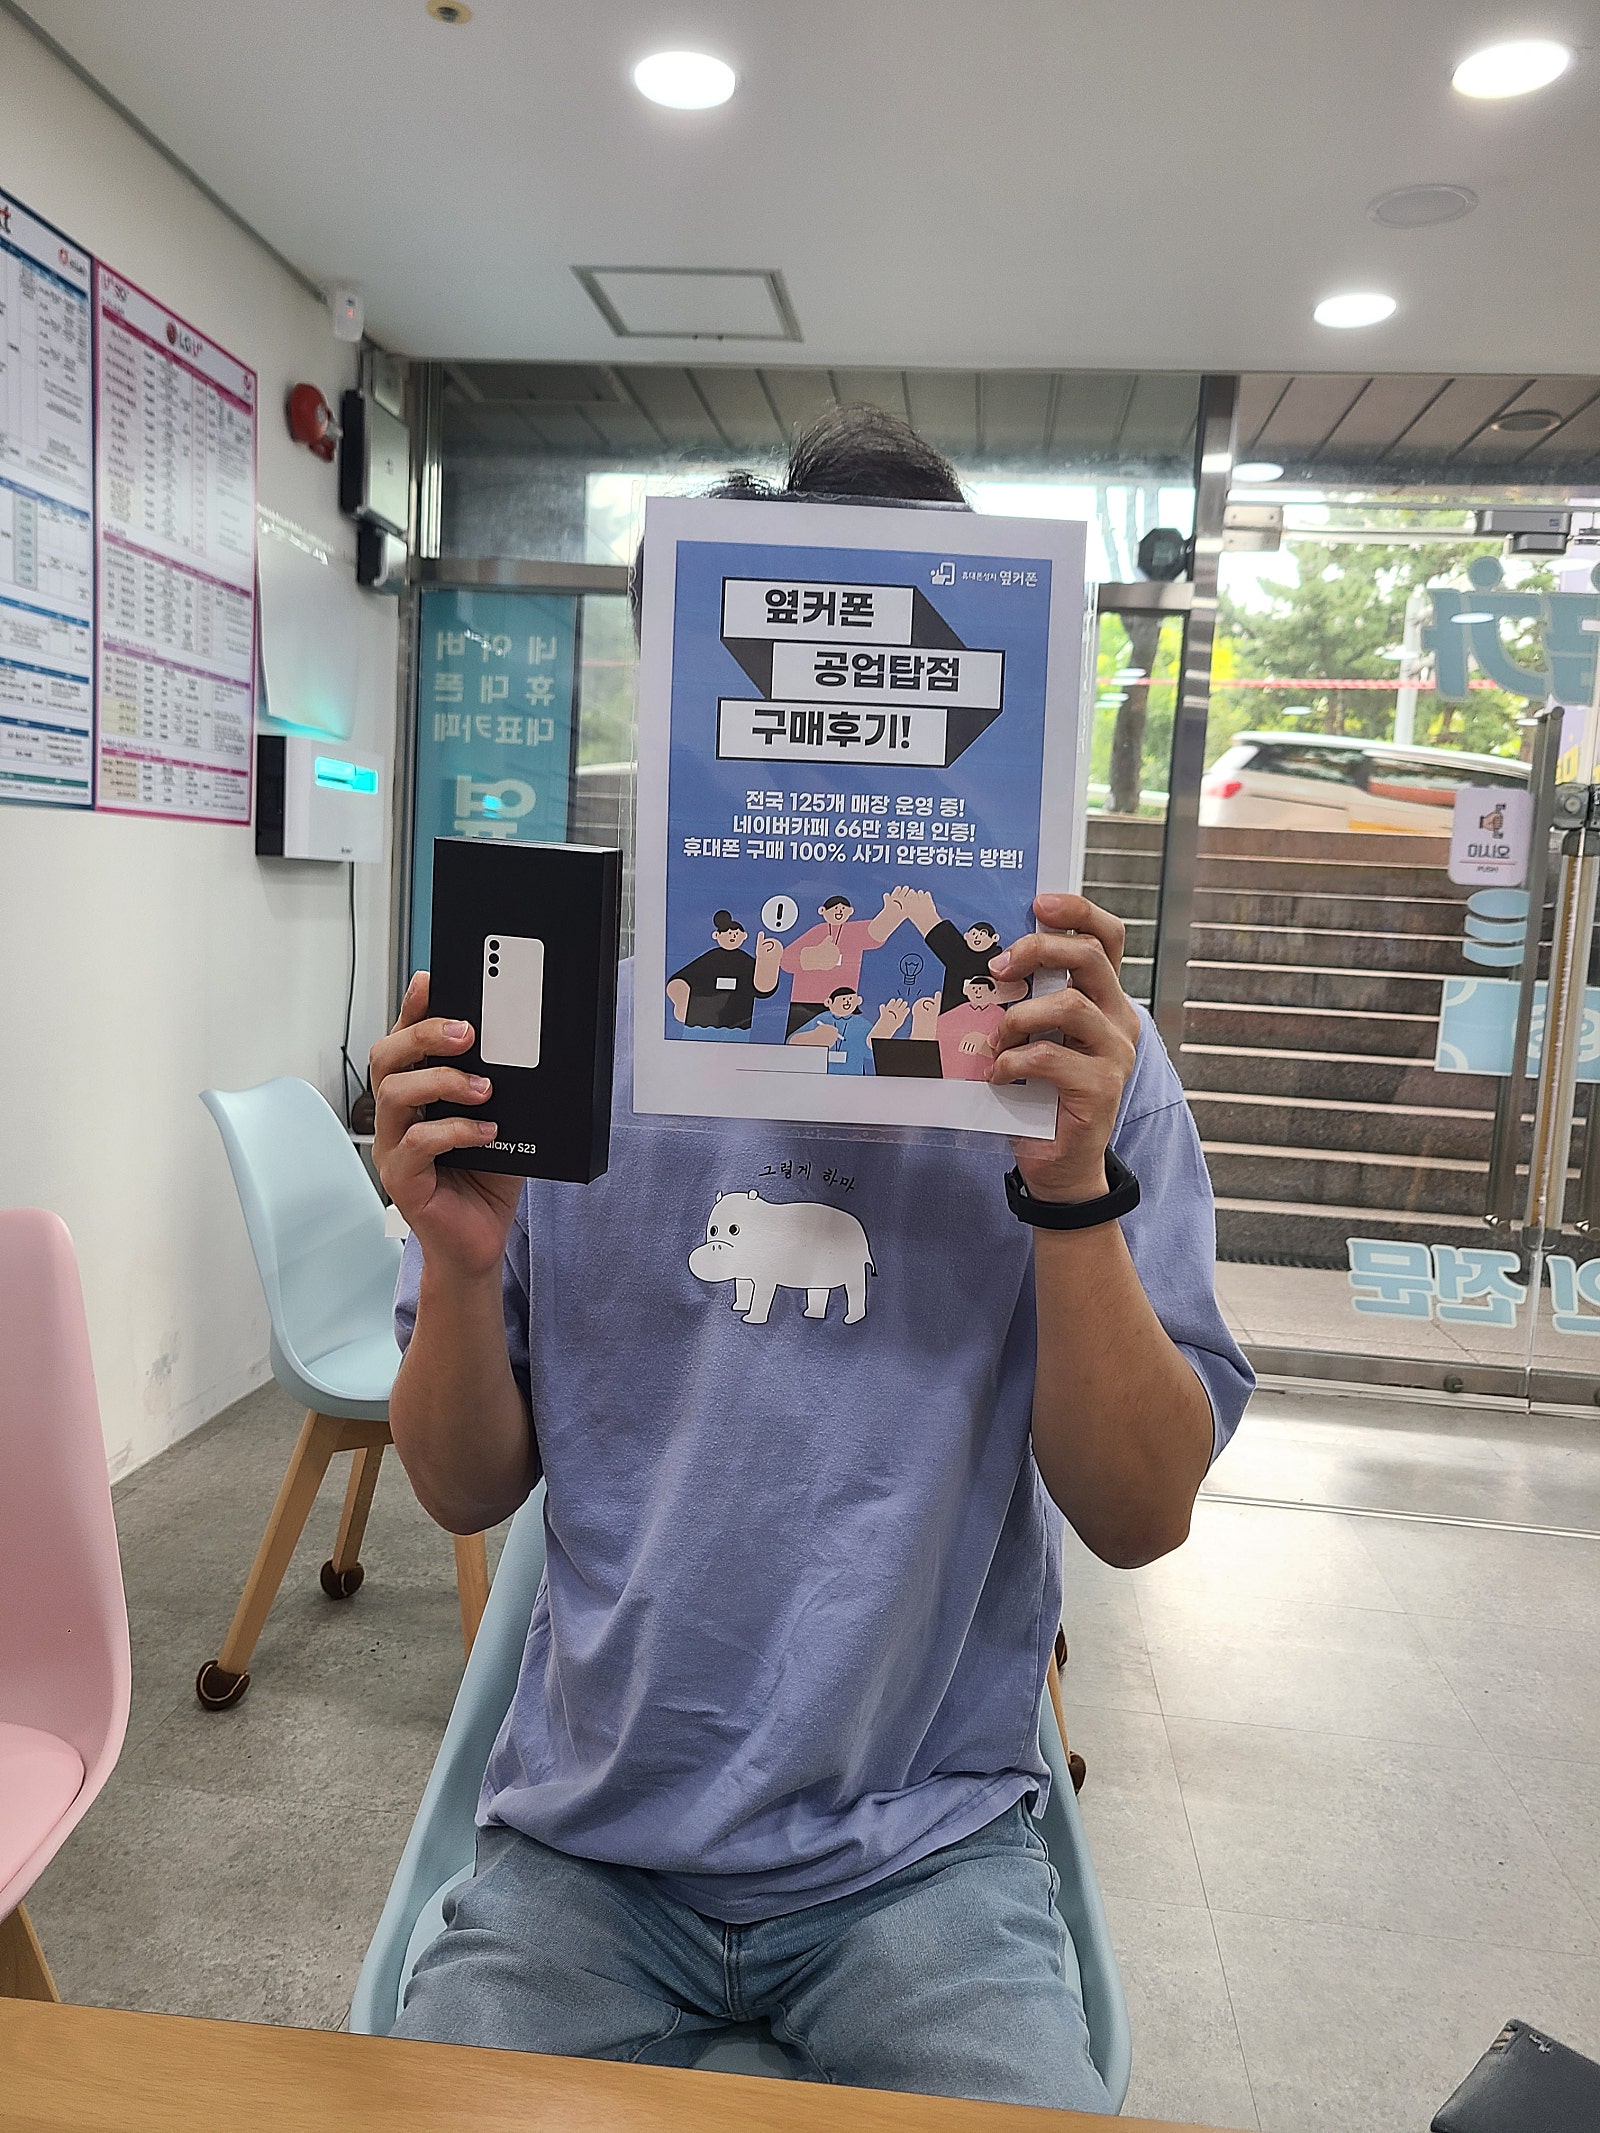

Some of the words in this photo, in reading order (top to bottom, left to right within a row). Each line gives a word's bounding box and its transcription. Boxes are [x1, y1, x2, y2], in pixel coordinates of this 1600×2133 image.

[999, 570, 1038, 587] 옆커폰
[764, 588, 875, 628] 옆커폰
[813, 650, 961, 693] 공업탑점
[752, 707, 911, 750] 구매후기!
[746, 791, 783, 812] 전국
[789, 792, 845, 814] 125개
[851, 794, 889, 814] 매장
[895, 795, 933, 816] 운영
[939, 797, 966, 817] 중!
[733, 815, 829, 838] 네이버카페
[835, 819, 881, 839] 66만
[886, 820, 925, 841] 회원
[931, 821, 976, 842] 인증!
[683, 837, 740, 858] 휴대폰
[746, 840, 784, 860] 구매
[789, 842, 846, 862] 100%
[852, 845, 890, 865] 사기
[896, 847, 974, 868] 안당하는
[979, 849, 1023, 870] 방법!
[1467, 843, 1511, 859] 미시오
[481, 1140, 516, 1154] alaxy
[517, 1142, 537, 1155] S23
[758, 1160, 813, 1180] 그렇게
[822, 1167, 857, 1193] 하마
